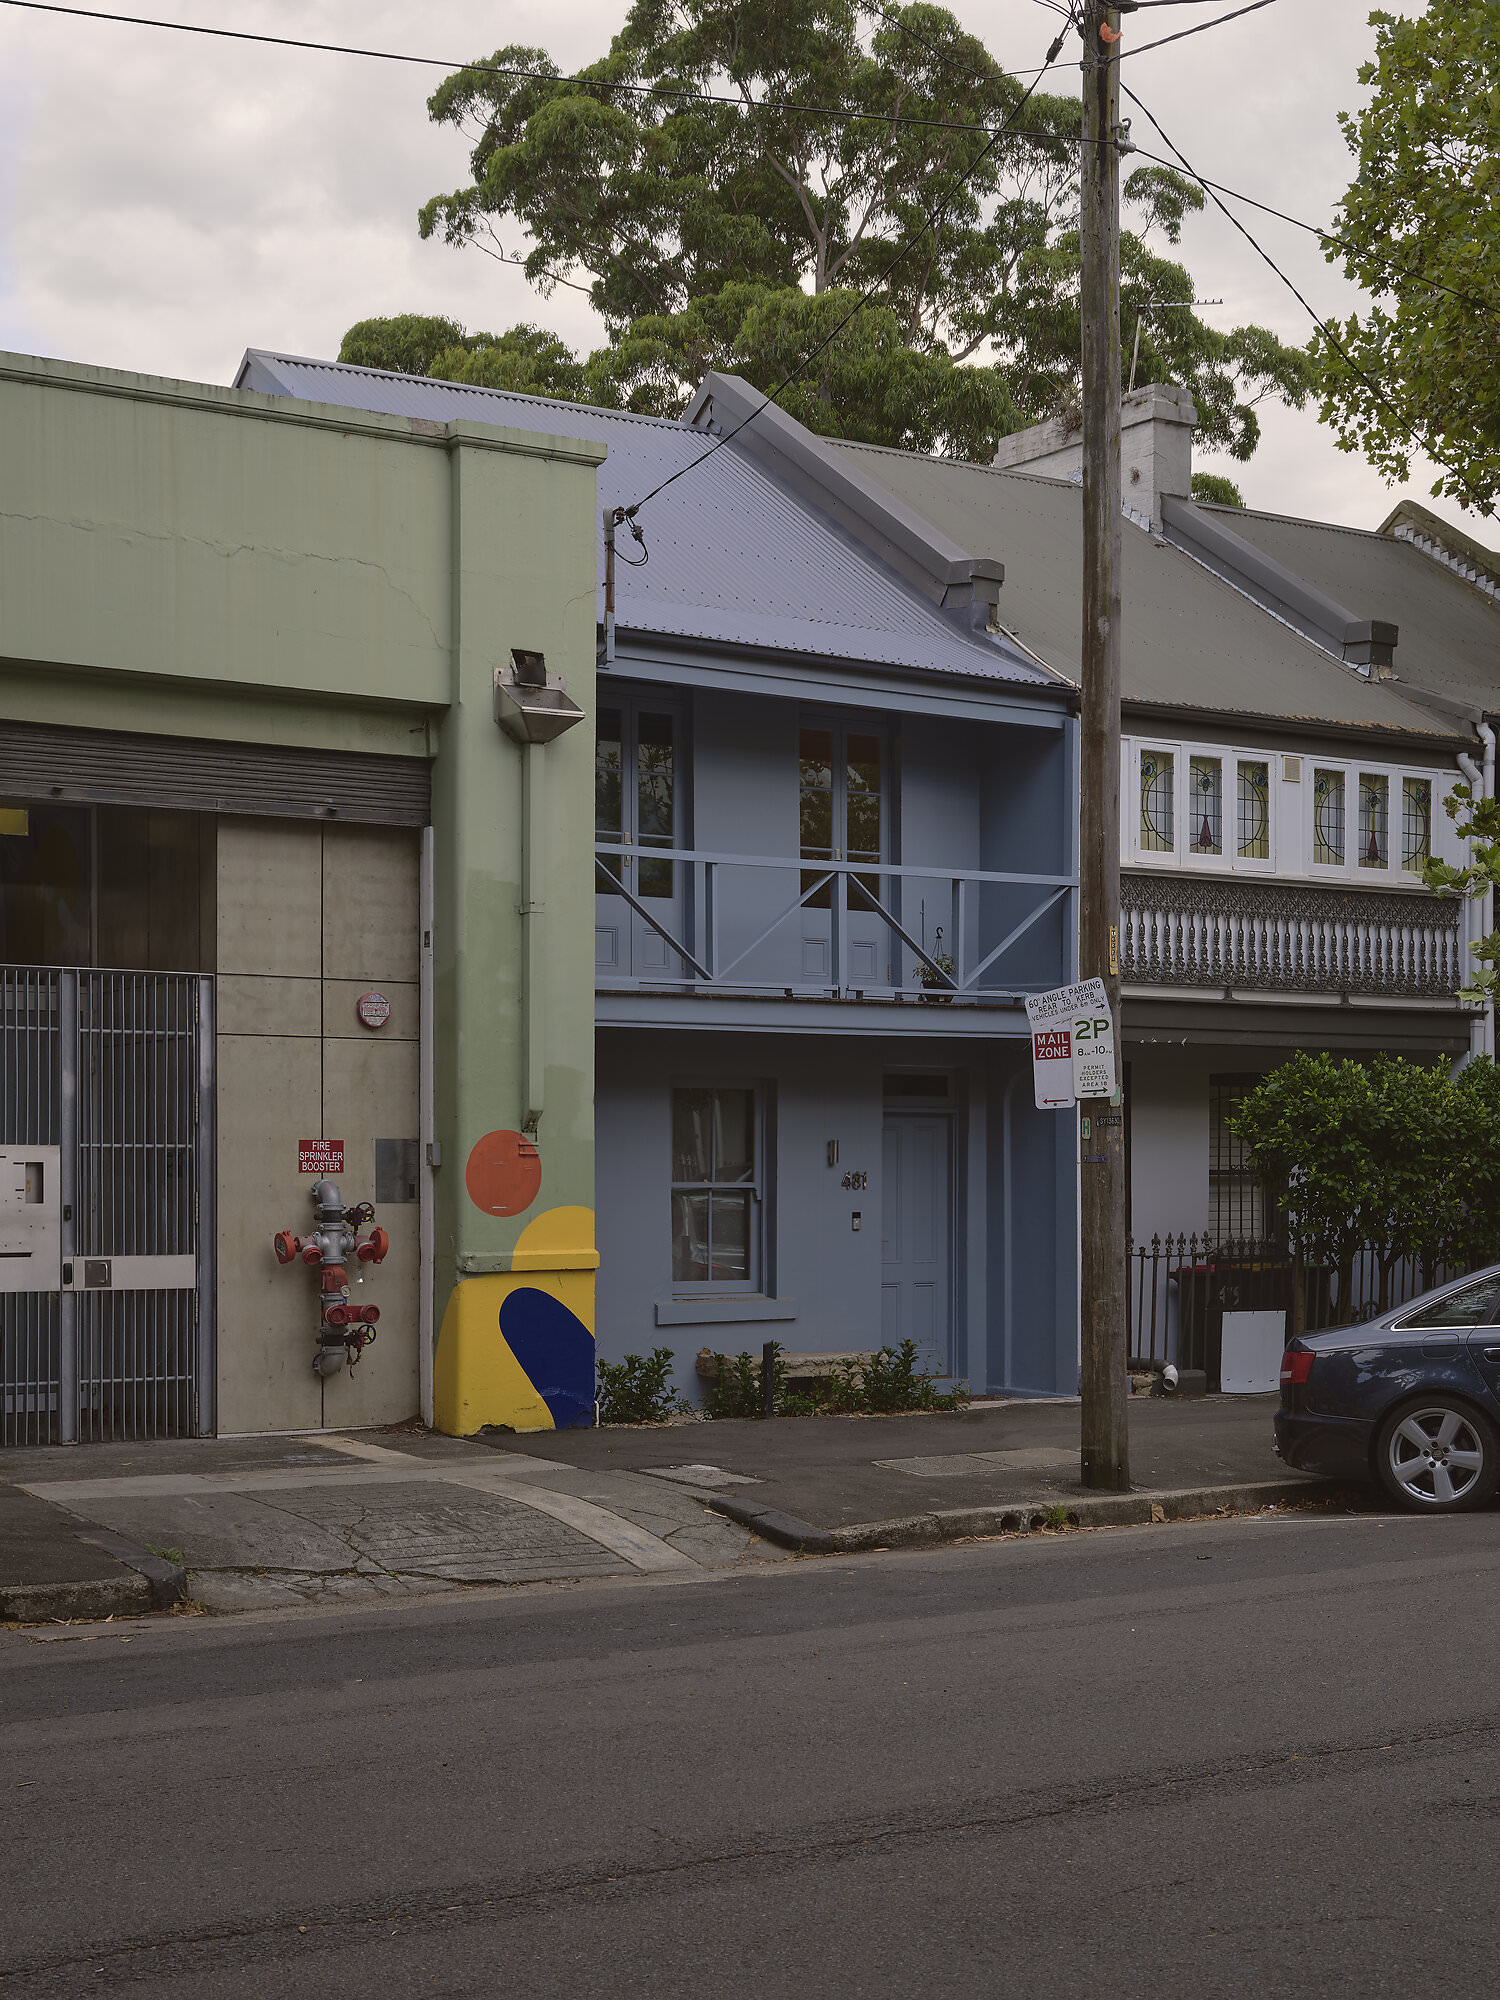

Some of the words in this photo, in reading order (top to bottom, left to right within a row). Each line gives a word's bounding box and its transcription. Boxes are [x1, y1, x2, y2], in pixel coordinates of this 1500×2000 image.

[1042, 990, 1067, 1005] ANGLE
[1068, 980, 1101, 996] PARKING
[1031, 1010, 1059, 1022] VEHICLES
[1059, 1003, 1079, 1014] UNDER
[1089, 995, 1105, 1005] ONLY
[1038, 1002, 1058, 1014] REAR
[1076, 991, 1095, 1002] KERB
[1074, 1019, 1110, 1040] 2P
[1037, 1033, 1069, 1046] MAIL
[1037, 1046, 1070, 1058] ZONE
[1082, 1119, 1090, 1135] H
[311, 1141, 331, 1151] FIRE
[299, 1151, 343, 1161] SPRINKLER
[302, 1161, 341, 1171] BOOSTER
[841, 1169, 867, 1190] 481
